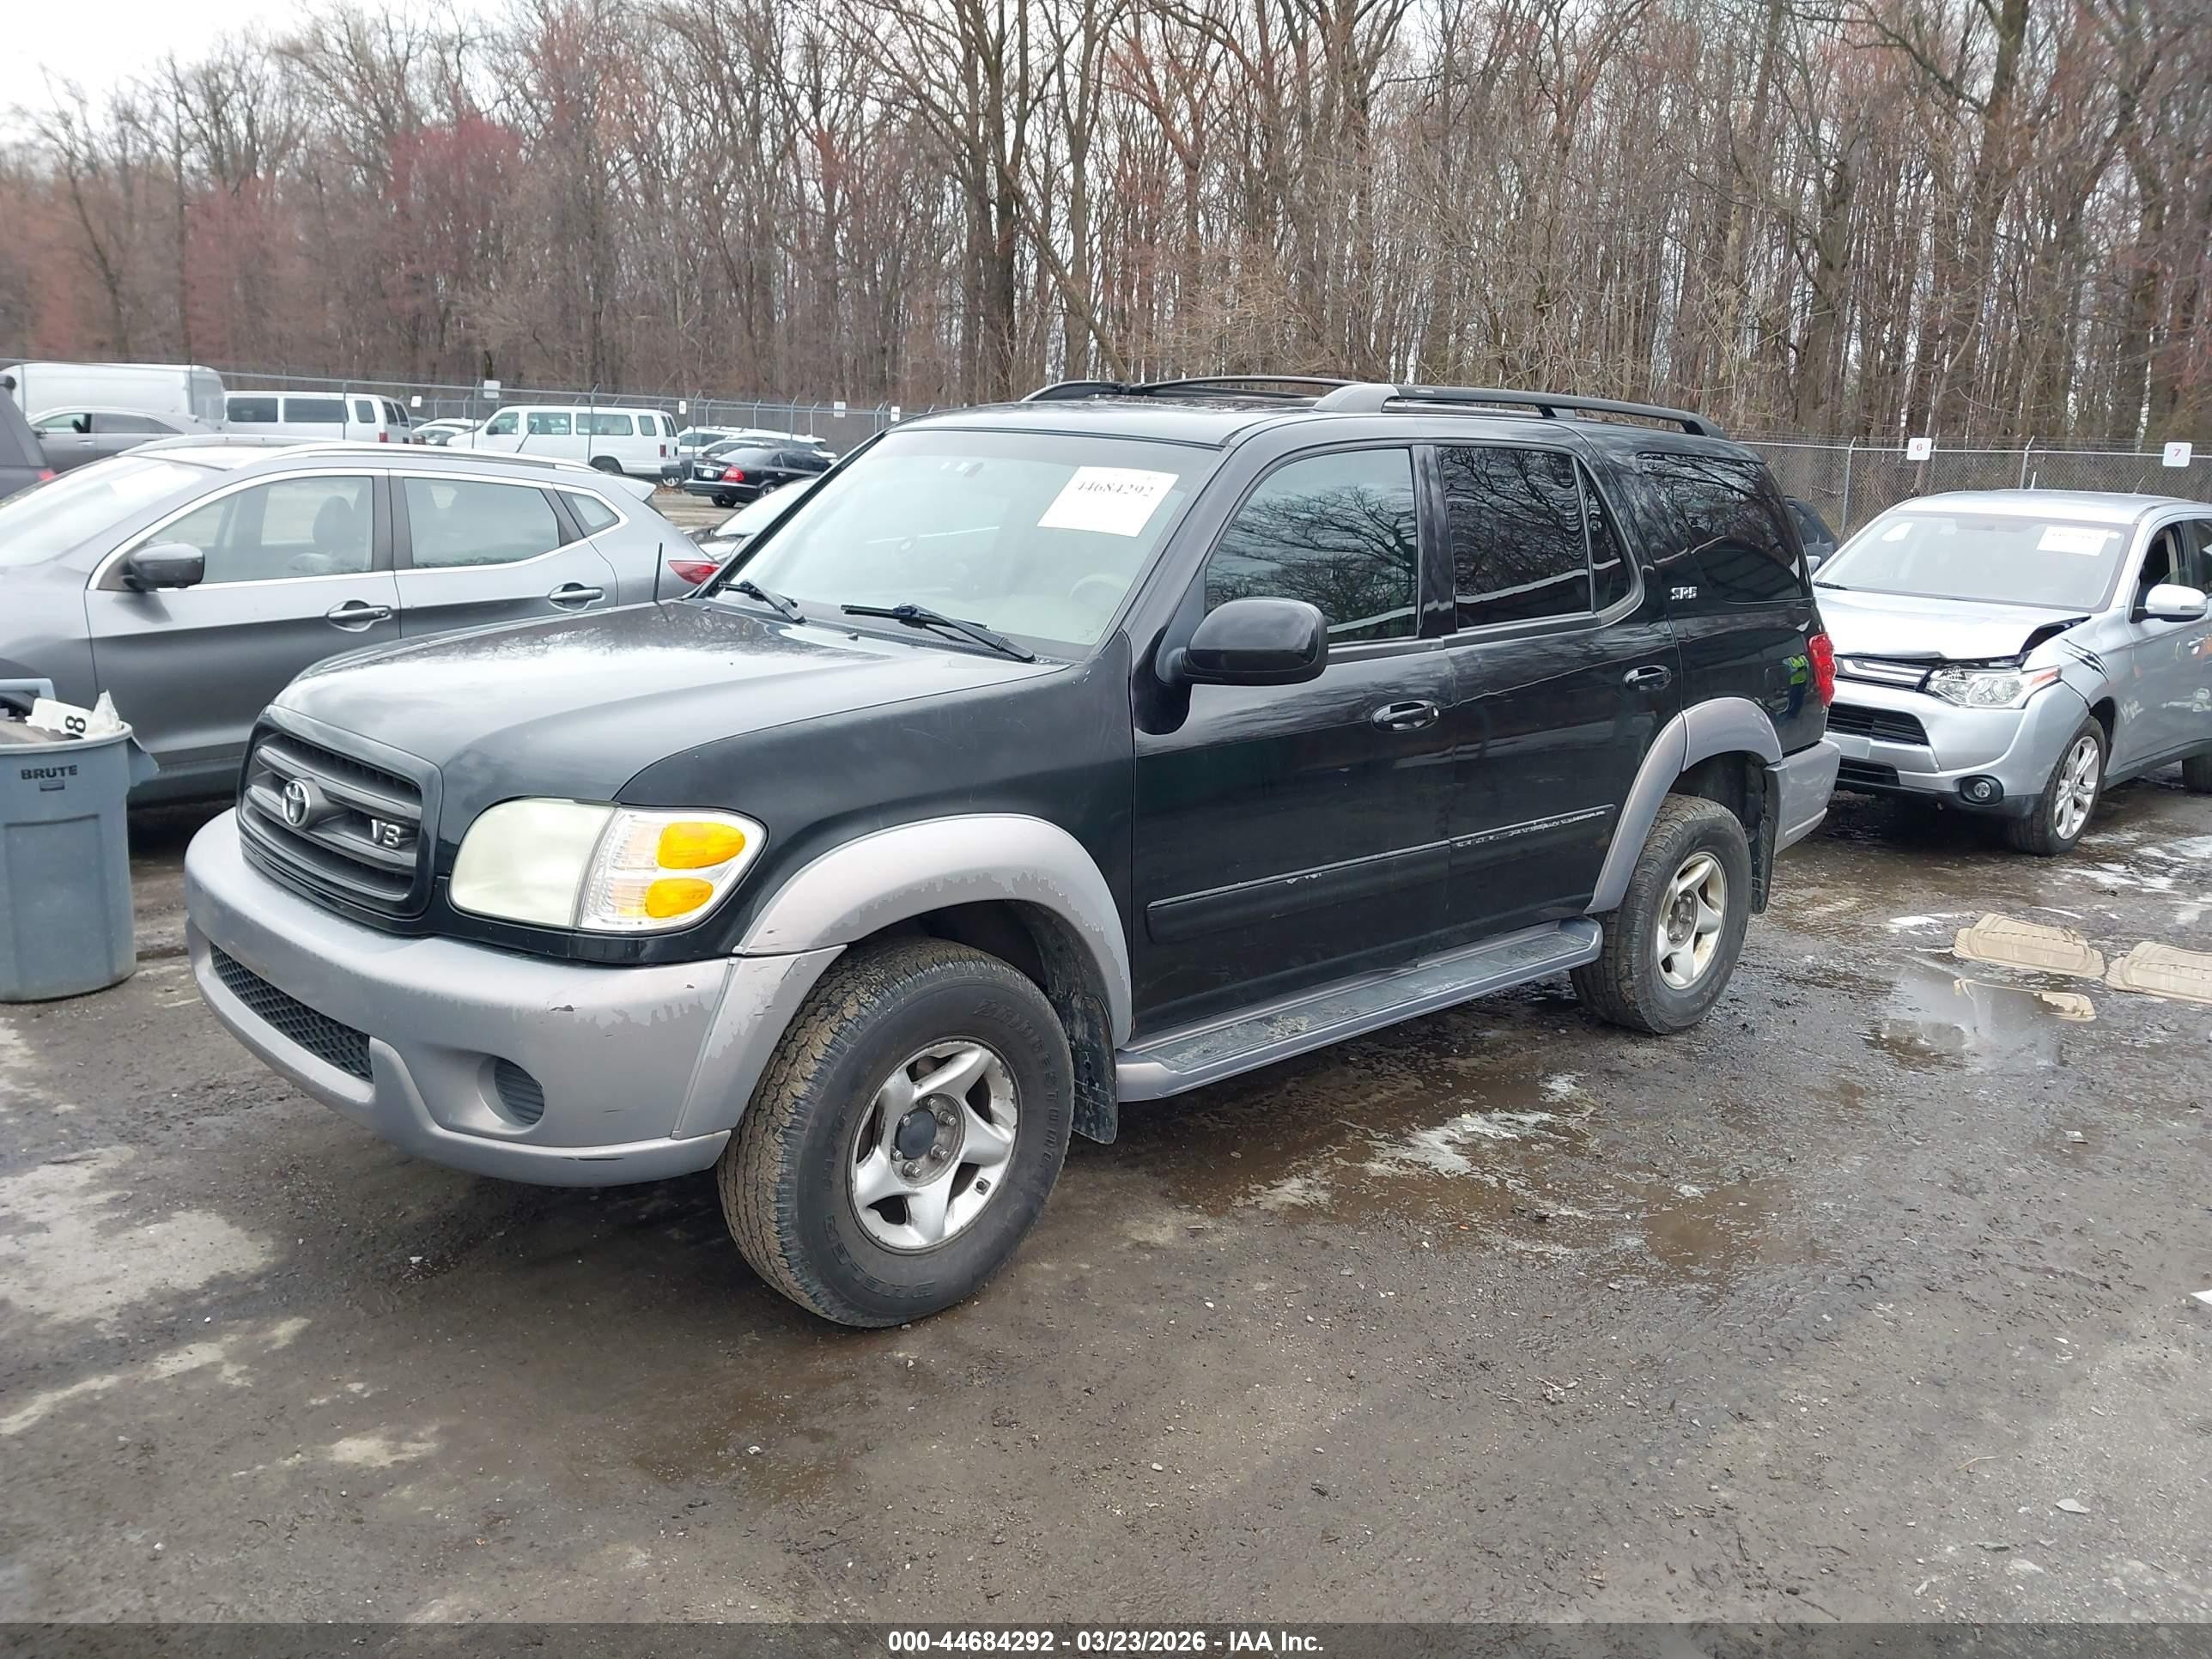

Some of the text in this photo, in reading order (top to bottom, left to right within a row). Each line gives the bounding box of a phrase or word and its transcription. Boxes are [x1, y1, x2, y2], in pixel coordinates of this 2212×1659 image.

[1916, 443, 1923, 453] 6
[2173, 447, 2182, 458] 7
[64, 714, 87, 733] 8
[21, 764, 78, 780] BRUTE
[371, 818, 402, 848] V8
